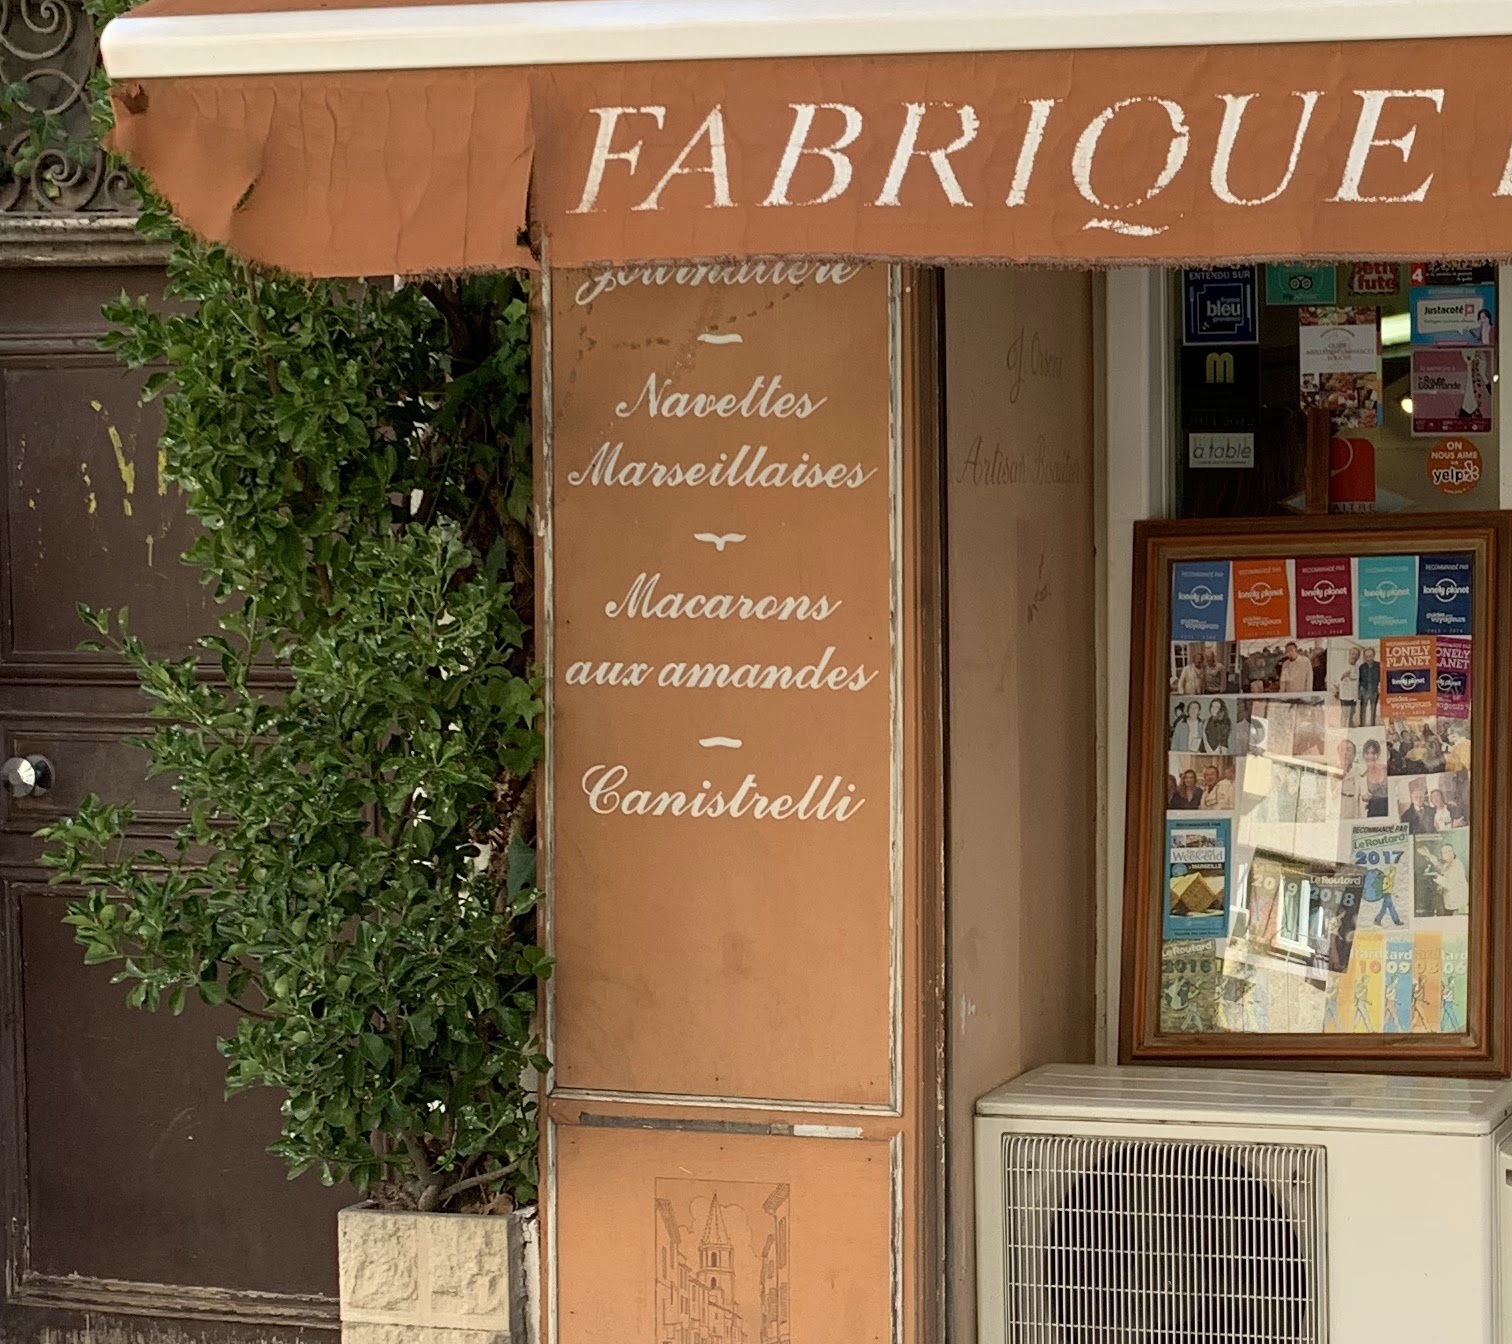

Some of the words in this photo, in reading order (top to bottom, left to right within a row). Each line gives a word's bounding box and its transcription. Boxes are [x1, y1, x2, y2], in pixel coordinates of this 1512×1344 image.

[566, 87, 1445, 236] FABRIQUE
[1188, 271, 1230, 281] ENTENDU
[1232, 269, 1251, 279] SUR
[1412, 268, 1424, 283] 4
[1206, 299, 1241, 317] bleu
[1424, 304, 1464, 315] Justacoté
[615, 372, 827, 419] Navettes
[1446, 441, 1462, 450] ON
[1431, 451, 1455, 459] NOUS
[1456, 451, 1478, 459] AIME
[568, 442, 878, 488] Marseillaises
[1432, 467, 1465, 485] yelp
[605, 572, 843, 621] Macarons
[1301, 588, 1323, 599] lonely
[1324, 586, 1347, 596] planet
[1423, 585, 1445, 596] lonely
[1446, 586, 1469, 596] planet
[1386, 646, 1430, 657] LONELY
[1386, 656, 1431, 667] PLANET
[565, 660, 655, 687] aux
[658, 646, 879, 692] amandes
[581, 763, 866, 822] Canistrelli
[1353, 824, 1394, 834] RECOMMANDÉ
[1354, 840, 1365, 850] Le
[1365, 834, 1406, 847] Routard
[1172, 850, 1222, 862] Week-end
[1355, 850, 1405, 865] 2017
[1310, 875, 1320, 884] Le
[1321, 875, 1361, 885] Routard
[1310, 886, 1355, 907] 2018
[1172, 941, 1212, 955] Routard
[1386, 960, 1411, 974] 09
